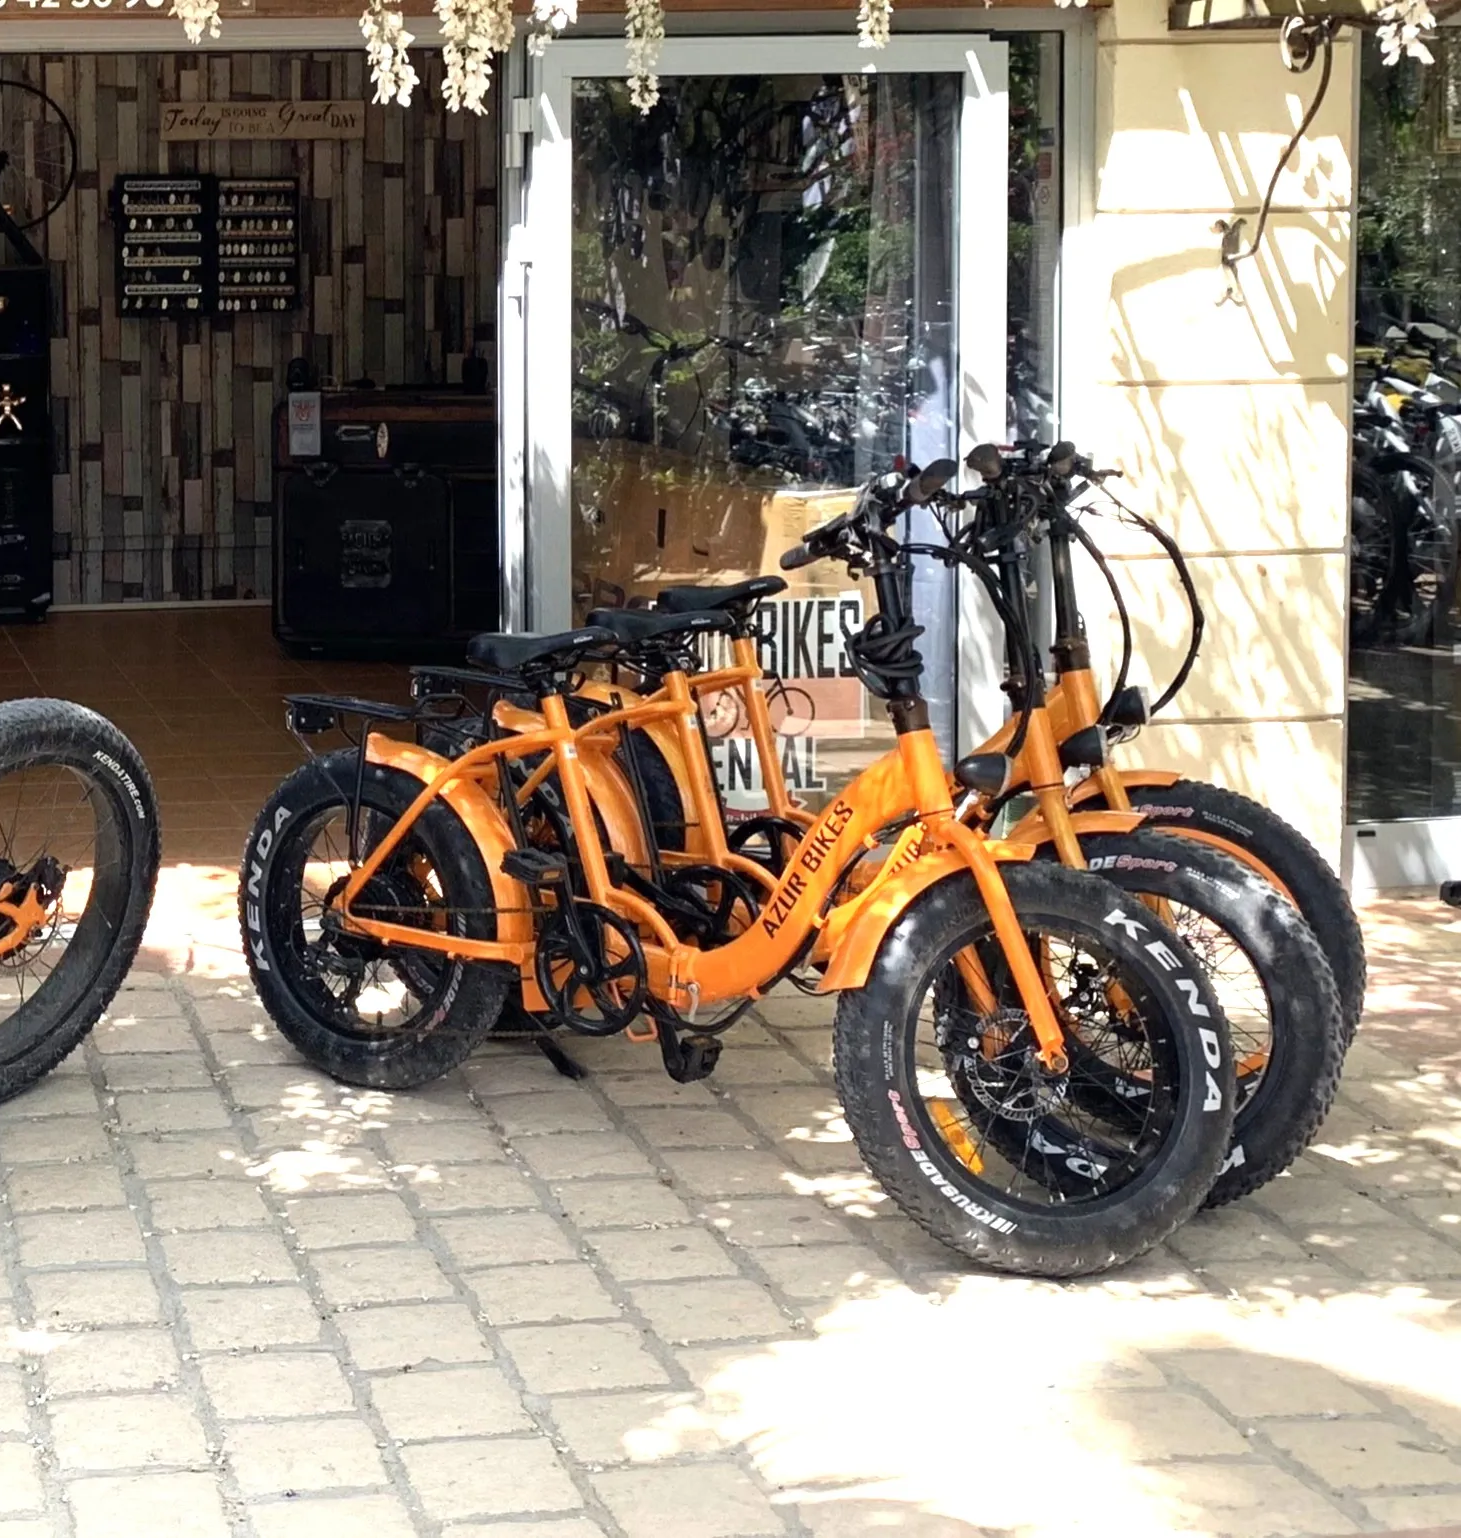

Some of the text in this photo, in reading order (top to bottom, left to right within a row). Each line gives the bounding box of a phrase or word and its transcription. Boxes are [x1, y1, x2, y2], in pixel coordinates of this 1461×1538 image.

[164, 105, 221, 136] Today
[278, 102, 357, 136] Great DAY
[756, 600, 860, 679] BIKES
[92, 750, 146, 819] KENDATIRE.COM
[246, 805, 292, 972] KENDA
[762, 800, 854, 939] AZUR BIKES
[1103, 908, 1223, 1112] KENDA
